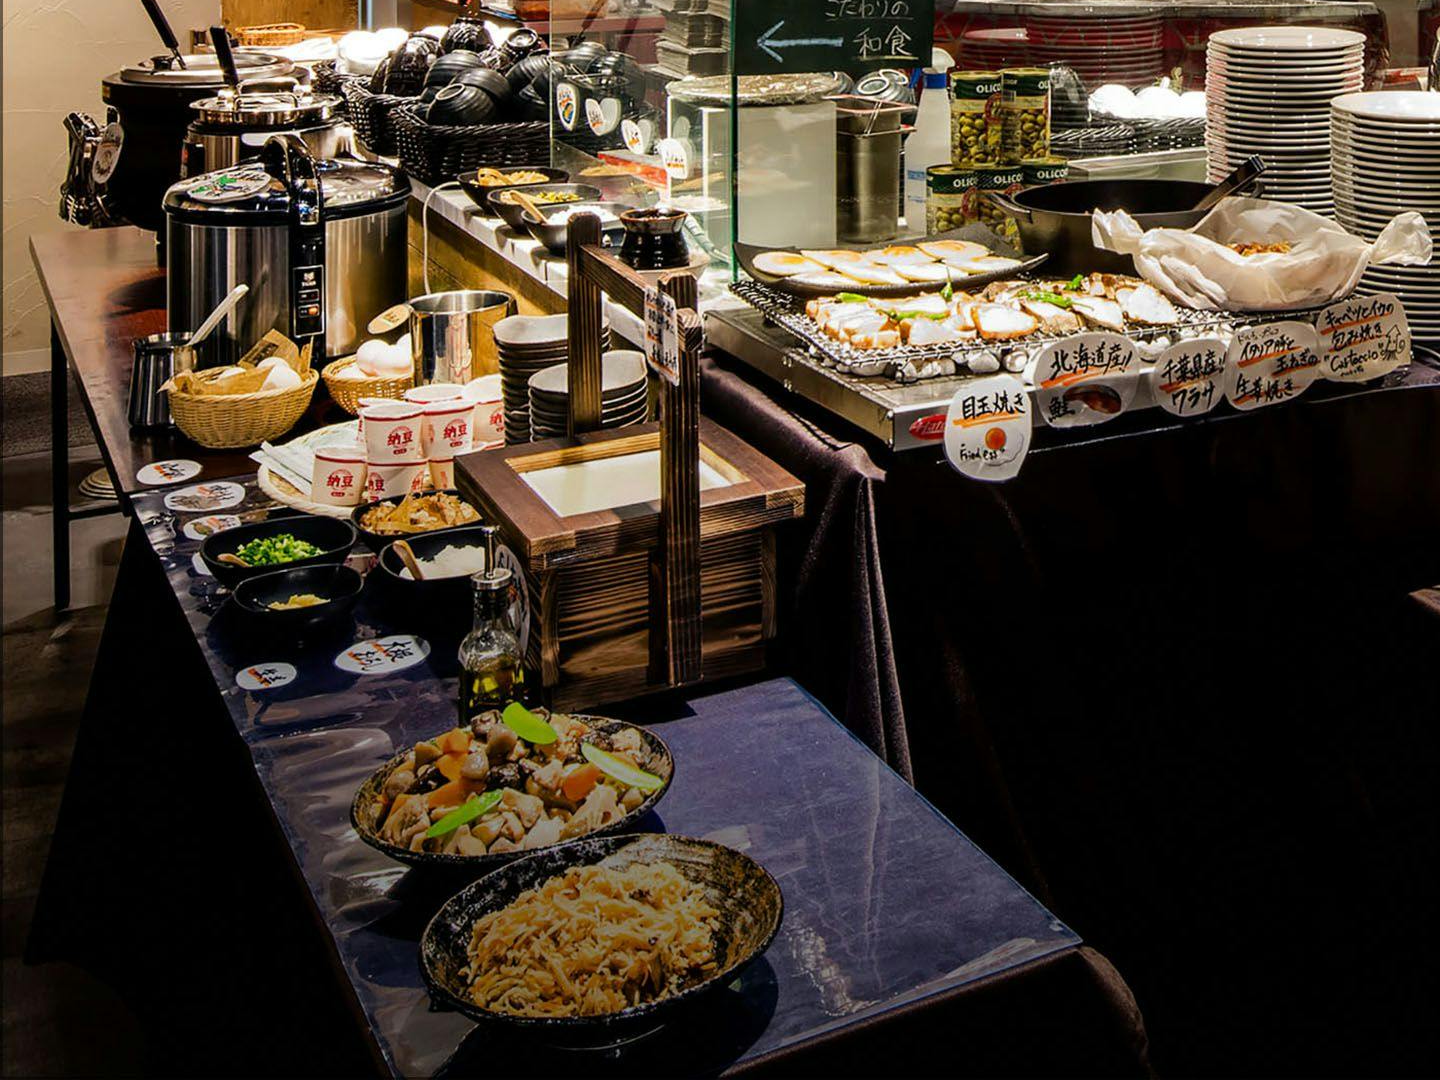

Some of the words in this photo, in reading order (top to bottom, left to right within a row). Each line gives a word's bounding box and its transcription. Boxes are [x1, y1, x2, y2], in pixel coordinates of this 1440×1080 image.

[852, 24, 913, 60] 和食
[961, 389, 1026, 421] 目玉焼き
[1048, 391, 1076, 423] 鮭
[1171, 380, 1217, 415] ワラサ
[386, 429, 414, 447] 納豆
[443, 422, 469, 440] 納豆
[326, 474, 354, 489] 納豆
